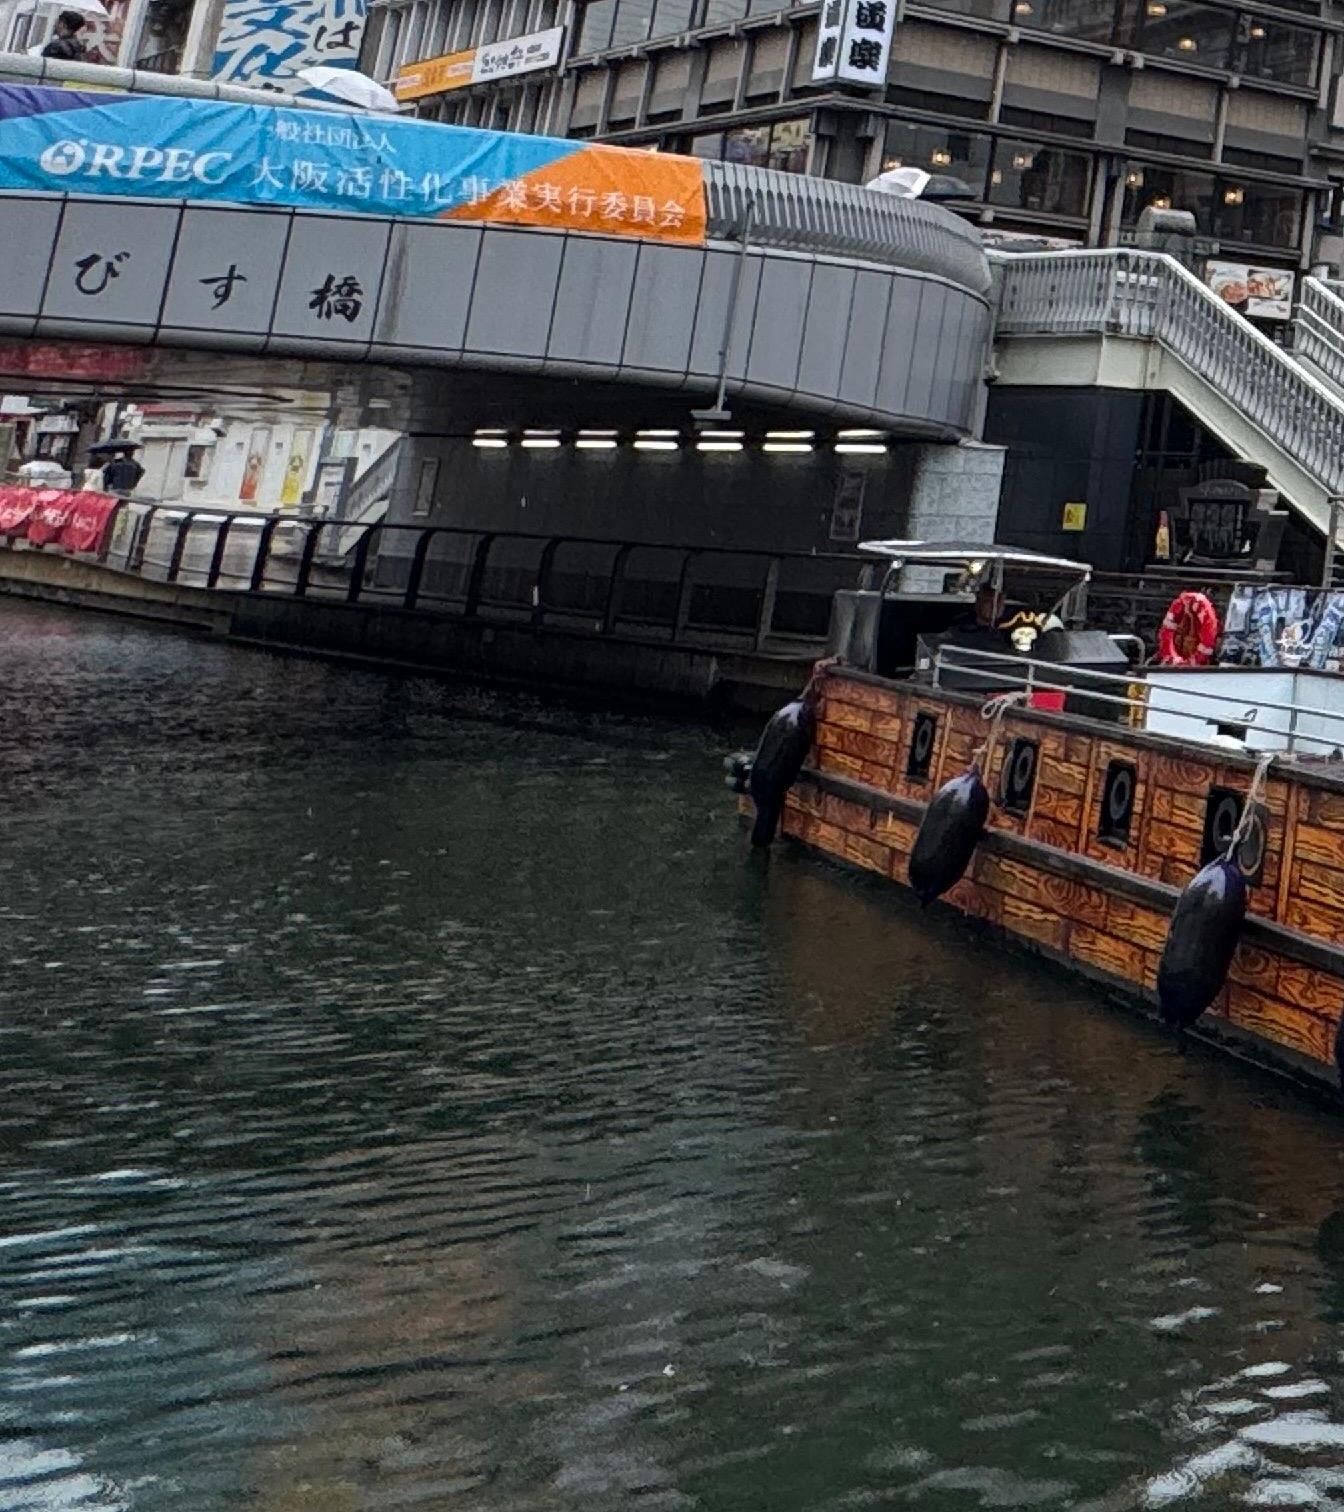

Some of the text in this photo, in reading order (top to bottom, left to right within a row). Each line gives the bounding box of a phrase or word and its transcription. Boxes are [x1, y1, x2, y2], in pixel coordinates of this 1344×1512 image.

[250, 158, 687, 229] 大阪活性化事業実行委員会
